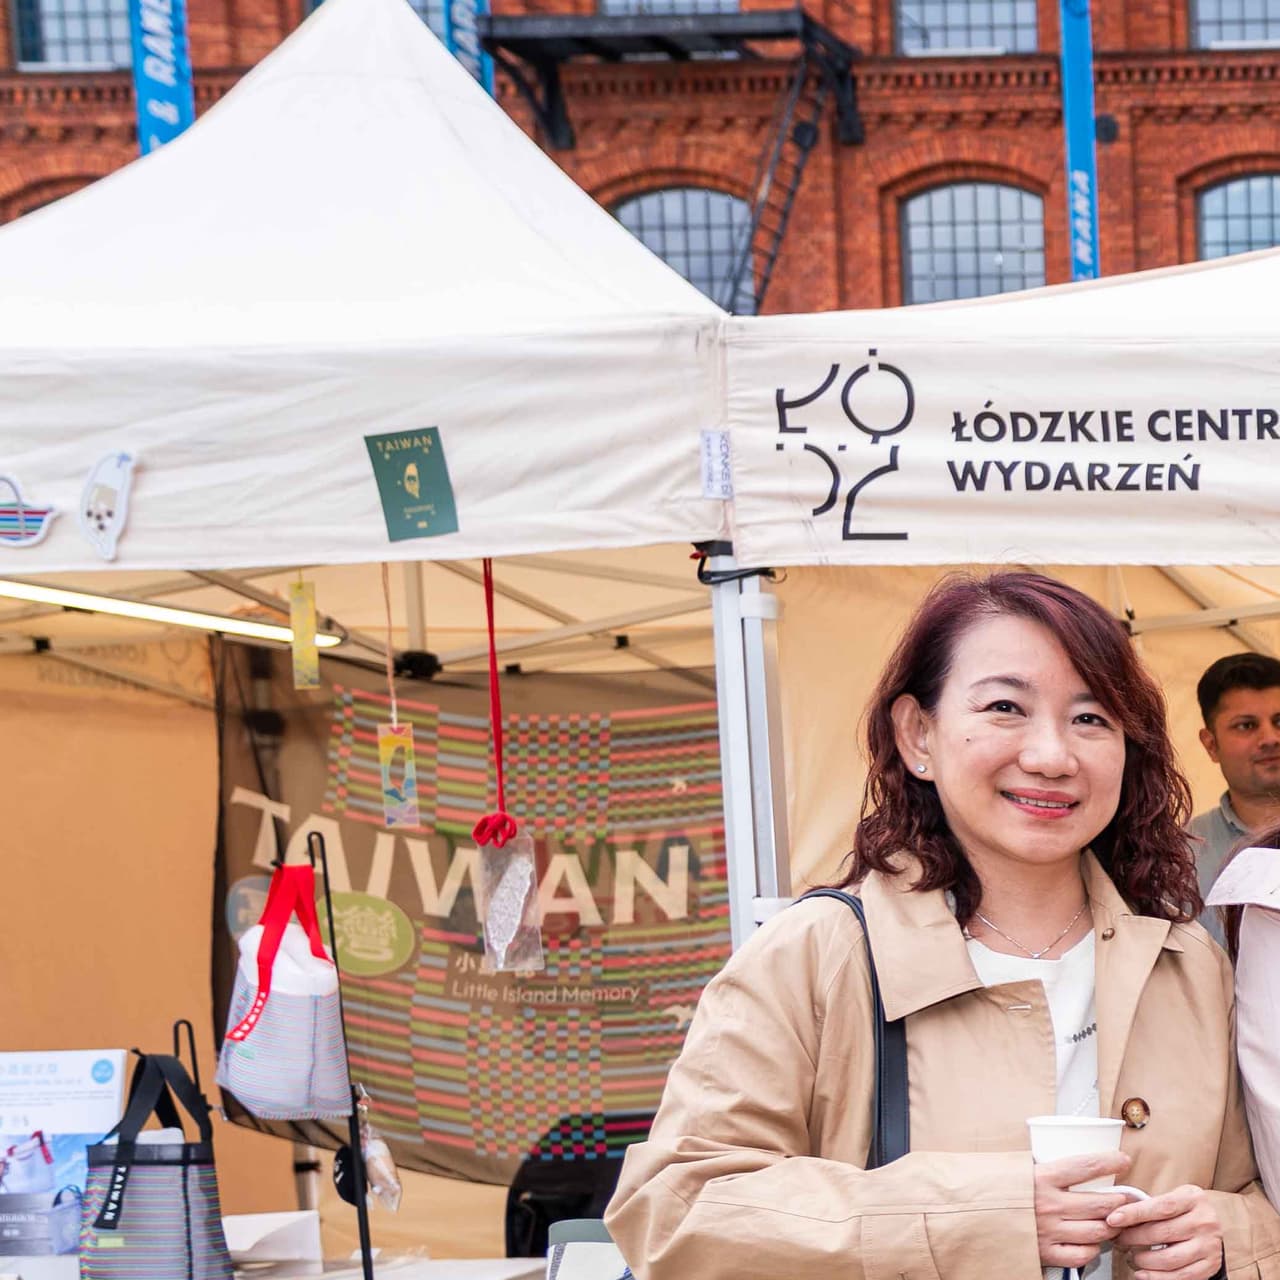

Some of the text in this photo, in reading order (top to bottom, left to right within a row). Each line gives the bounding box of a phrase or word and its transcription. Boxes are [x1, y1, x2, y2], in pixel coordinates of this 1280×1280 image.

[952, 400, 1135, 444] ŁÓDZKIE
[376, 434, 432, 453] TAIWAN
[946, 453, 1202, 492] WYDARZEŃ
[452, 980, 641, 1003] Little Island Memory
[103, 1166, 127, 1221] TAIWAN
